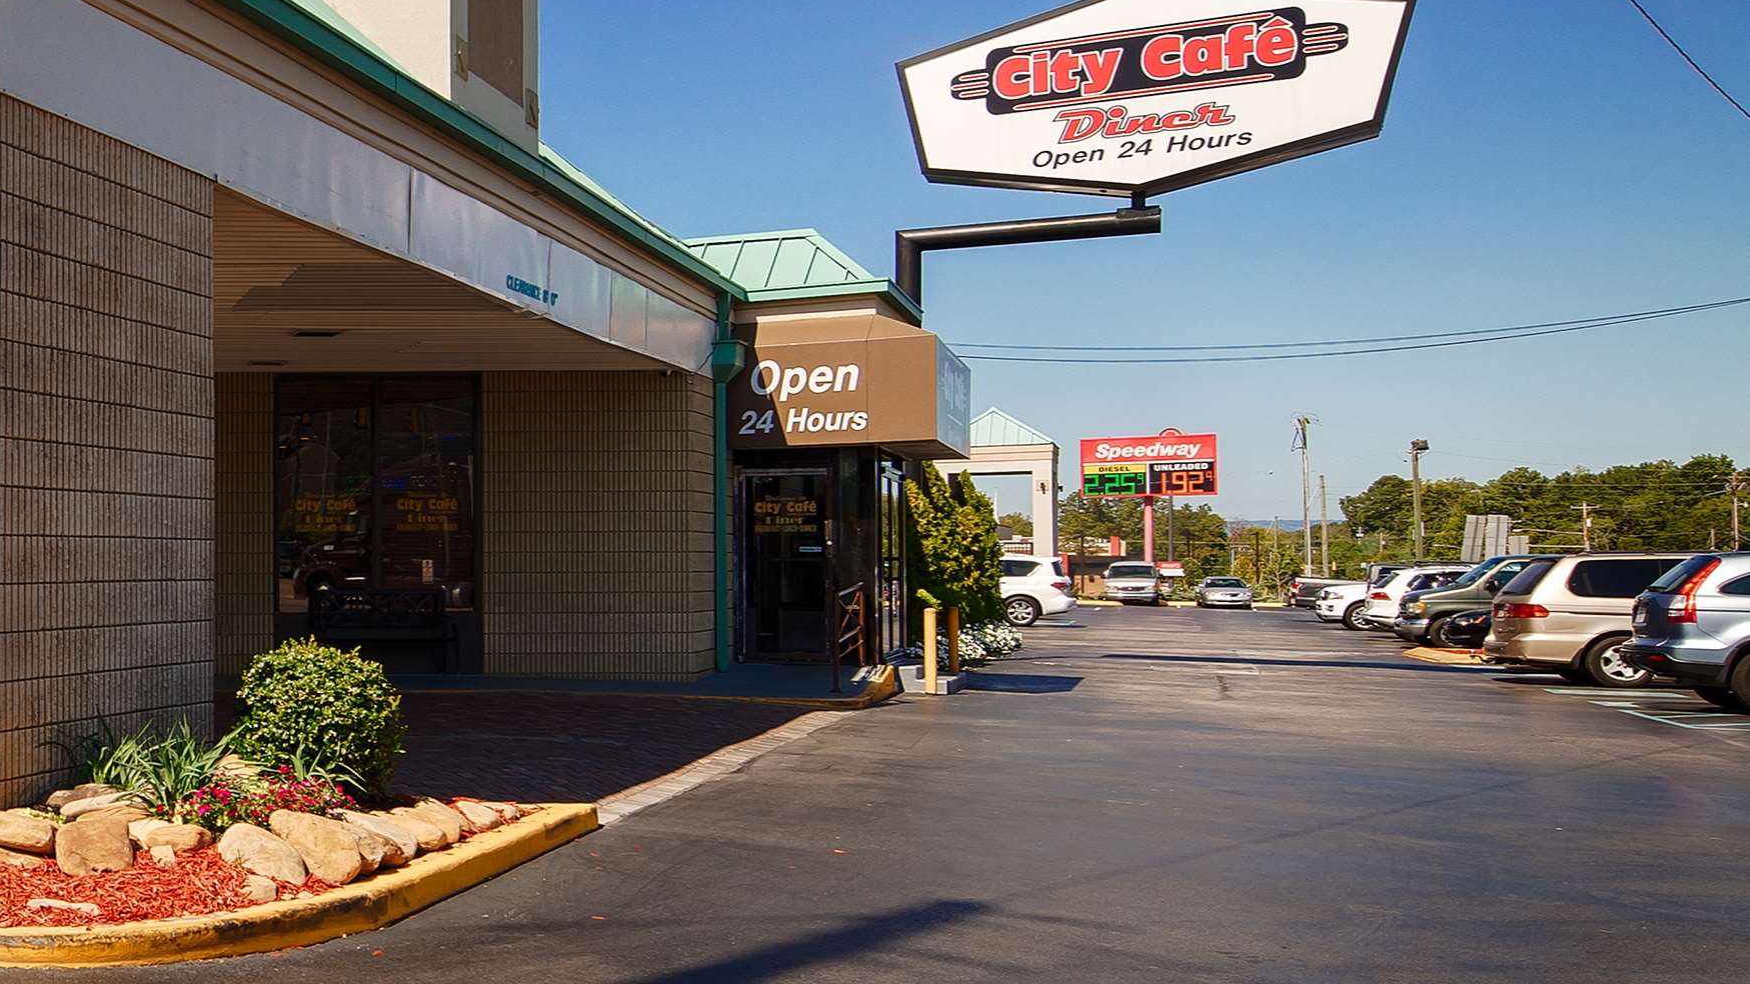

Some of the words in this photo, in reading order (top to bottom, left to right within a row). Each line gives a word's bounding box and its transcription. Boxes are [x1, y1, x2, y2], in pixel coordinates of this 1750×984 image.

[992, 47, 1123, 99] City
[1053, 102, 1235, 144] Diner
[1033, 148, 1105, 169] Open
[1118, 139, 1153, 159] 24
[1166, 131, 1253, 153] Hours
[751, 359, 859, 402] Open
[739, 409, 775, 435] 24
[786, 408, 868, 433] Hours
[1095, 442, 1202, 460] Speedway
[1153, 462, 1209, 472] UNLEADED
[396, 498, 422, 512] City
[754, 501, 782, 514] City
